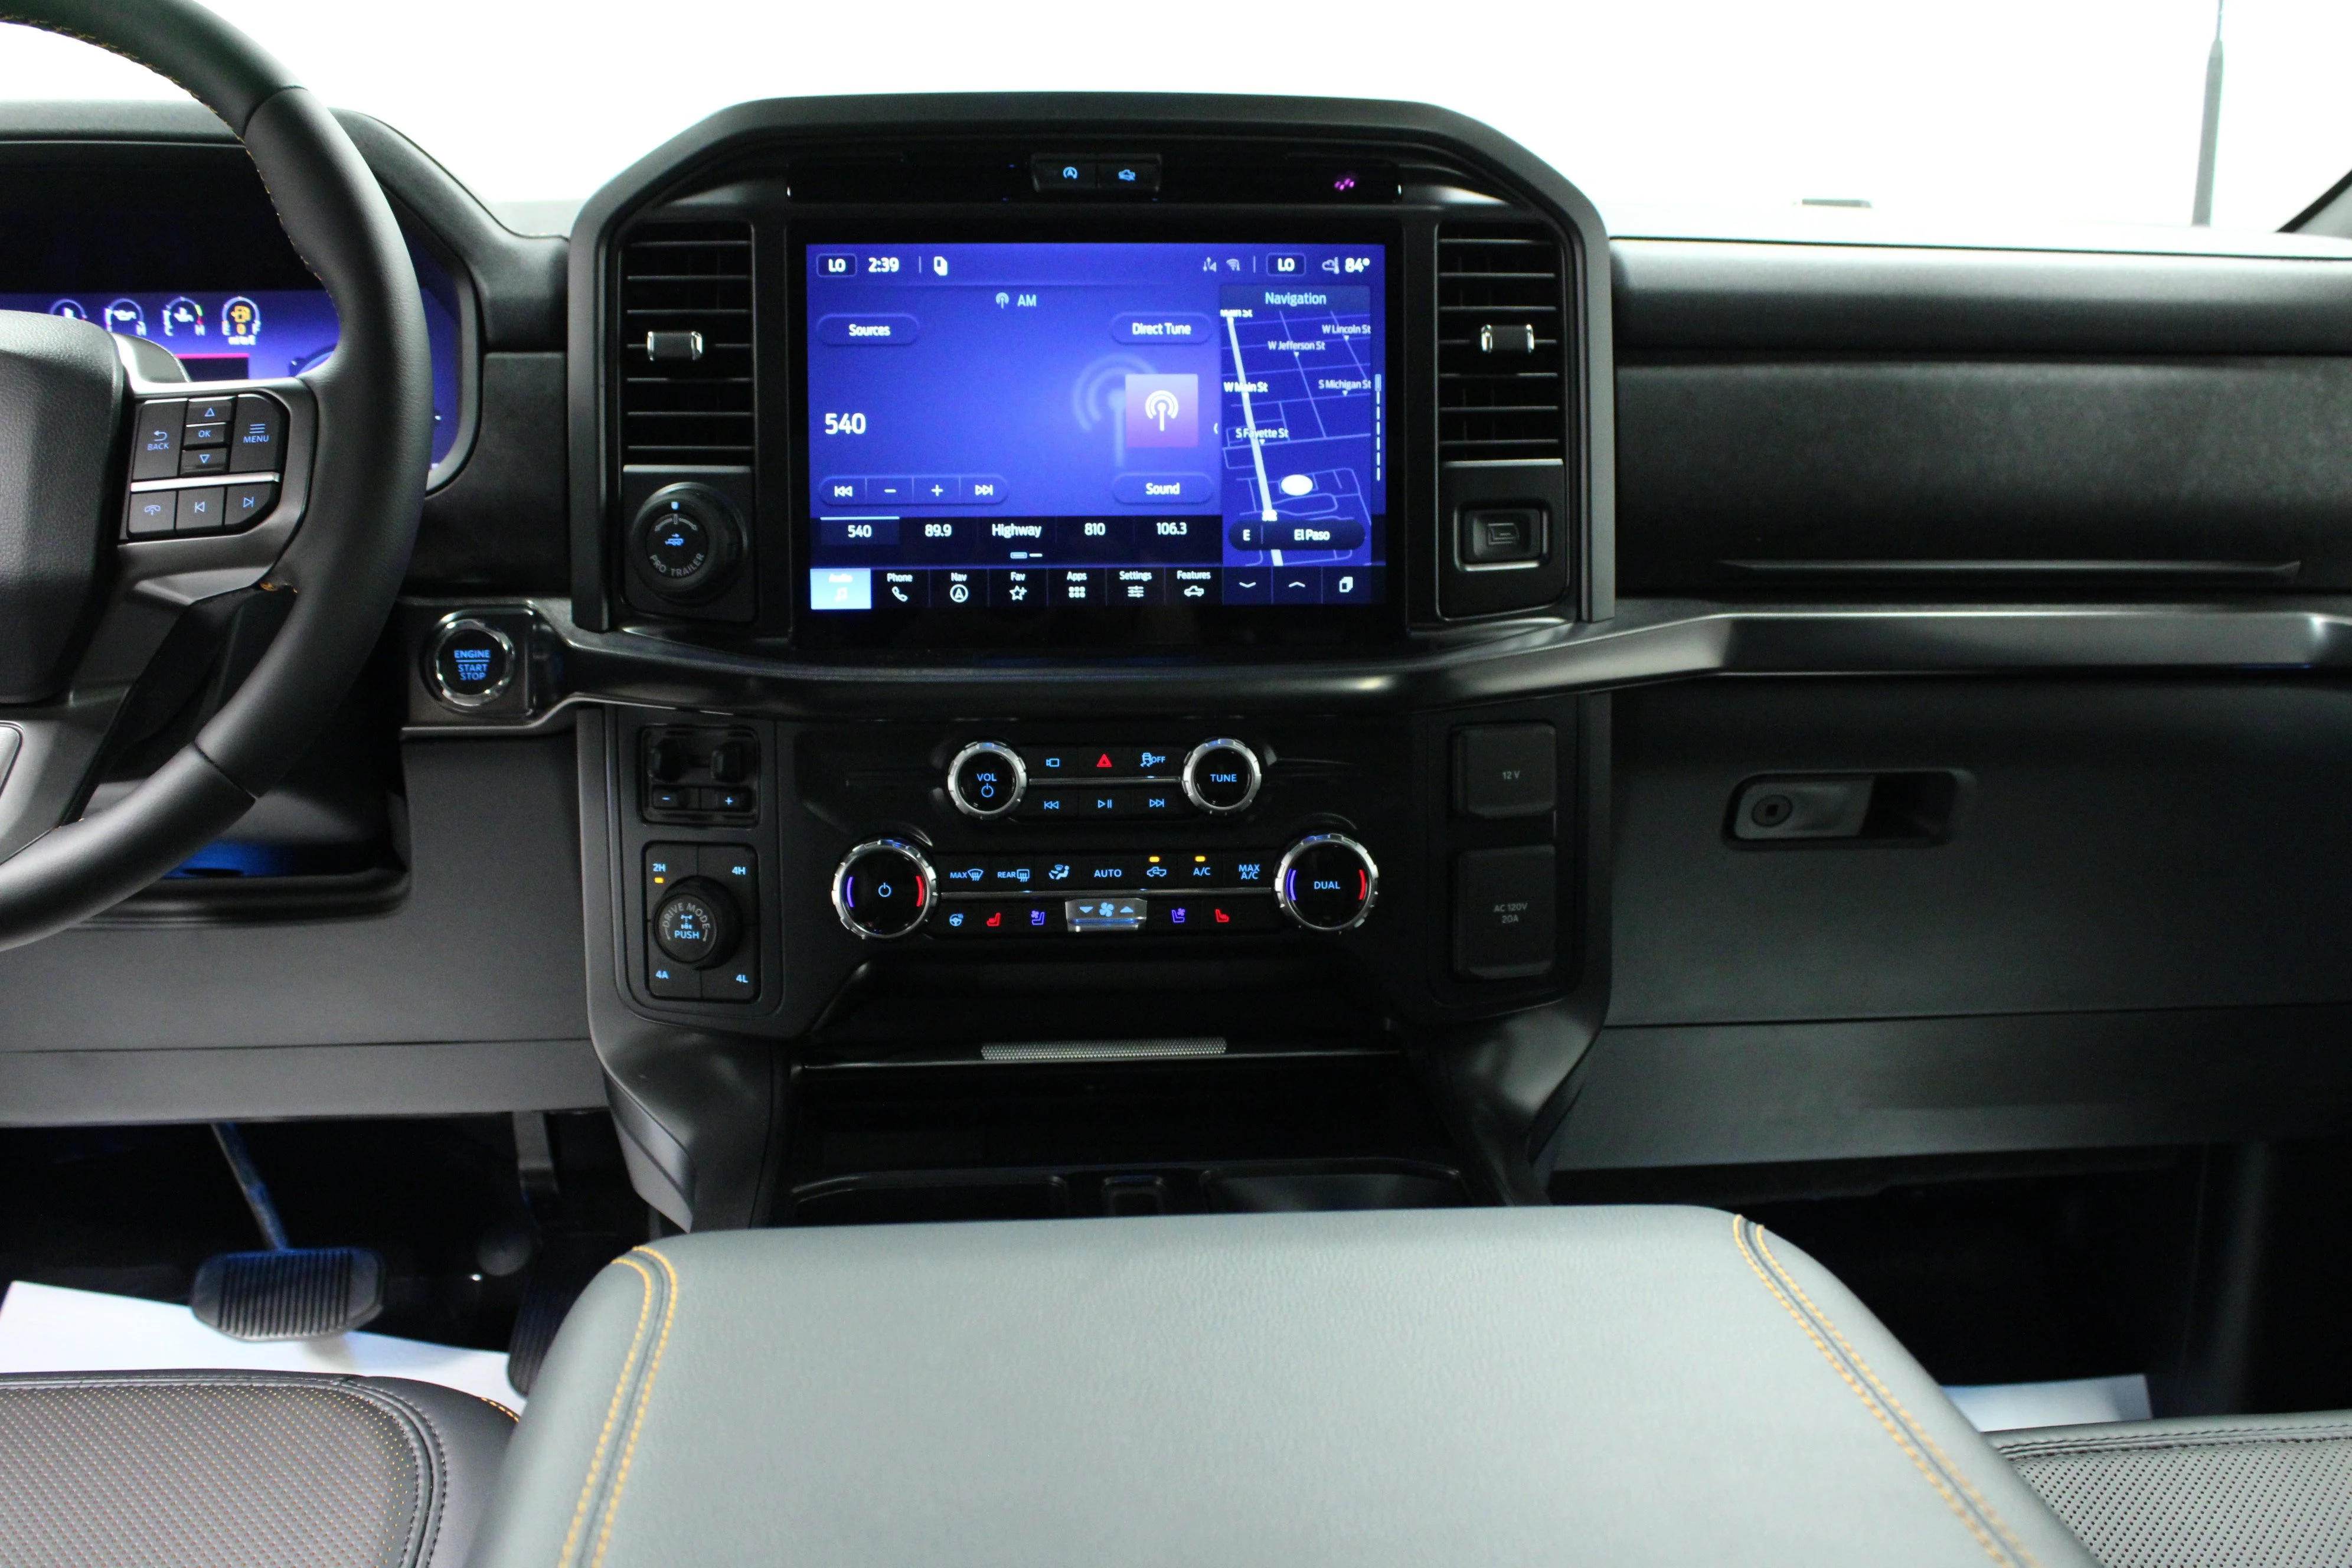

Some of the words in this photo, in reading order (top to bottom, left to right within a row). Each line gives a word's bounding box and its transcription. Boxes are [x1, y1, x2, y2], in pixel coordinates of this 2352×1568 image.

[828, 259, 846, 272] LO
[868, 257, 899, 273] 2:39
[1278, 258, 1295, 272] LO
[1345, 257, 1370, 272] 84°
[1017, 295, 1037, 307] AM
[1265, 292, 1327, 306] Navigation
[849, 324, 890, 337] Sources
[1132, 323, 1163, 335] Direct
[1164, 323, 1191, 335] Tune
[1322, 325, 1331, 334] W
[1332, 325, 1361, 334] Lincoln
[1362, 325, 1371, 334] St
[1268, 341, 1277, 350] W
[1278, 341, 1315, 350] Jefferson
[1315, 341, 1325, 350] St
[1223, 383, 1234, 392] W
[1235, 382, 1257, 392] Main
[1257, 382, 1268, 392] St
[1318, 380, 1325, 388] S
[1325, 379, 1362, 390] Michigan
[1363, 380, 1371, 388] St
[825, 413, 866, 435] 540
[198, 430, 211, 438] OK
[243, 434, 269, 443] MENU
[1236, 428, 1242, 438] S
[1243, 428, 1276, 439] Fayette
[1277, 428, 1289, 438] St
[147, 441, 169, 450] BACK
[1146, 483, 1180, 495] Sound
[848, 525, 871, 538] 540
[925, 524, 952, 537] 89.9
[992, 524, 1041, 538] Highway
[1084, 523, 1106, 536] 810
[1157, 522, 1187, 535] 106.3
[1243, 530, 1250, 541] E
[1294, 530, 1305, 541] El
[1306, 530, 1330, 541] Paso
[650, 554, 667, 573] PRO
[671, 553, 705, 577] TRAILER
[887, 573, 913, 582] Phone
[951, 573, 967, 582] Nav
[1010, 572, 1025, 581] Fav
[1067, 571, 1087, 583] Apps
[1119, 571, 1152, 581] Settings
[1177, 571, 1211, 580] Features
[454, 650, 491, 658] ENGINE
[458, 664, 488, 672] START
[977, 773, 997, 782] VOL
[1210, 774, 1237, 782] TUNE
[653, 864, 666, 872] 2H
[732, 867, 746, 875] 4H
[1094, 869, 1122, 877] AUTO
[1193, 867, 1211, 876] A/C
[1241, 871, 1258, 880] A/C
[1314, 881, 1340, 890] DUAL
[1493, 904, 1505, 913] AC
[1507, 903, 1528, 911] 120V
[662, 903, 684, 928] DRIVE
[687, 903, 711, 929] MODE
[1501, 915, 1518, 923] 20A
[674, 930, 700, 939] PUSH
[656, 971, 669, 979] 4A
[736, 974, 748, 983] 4L
